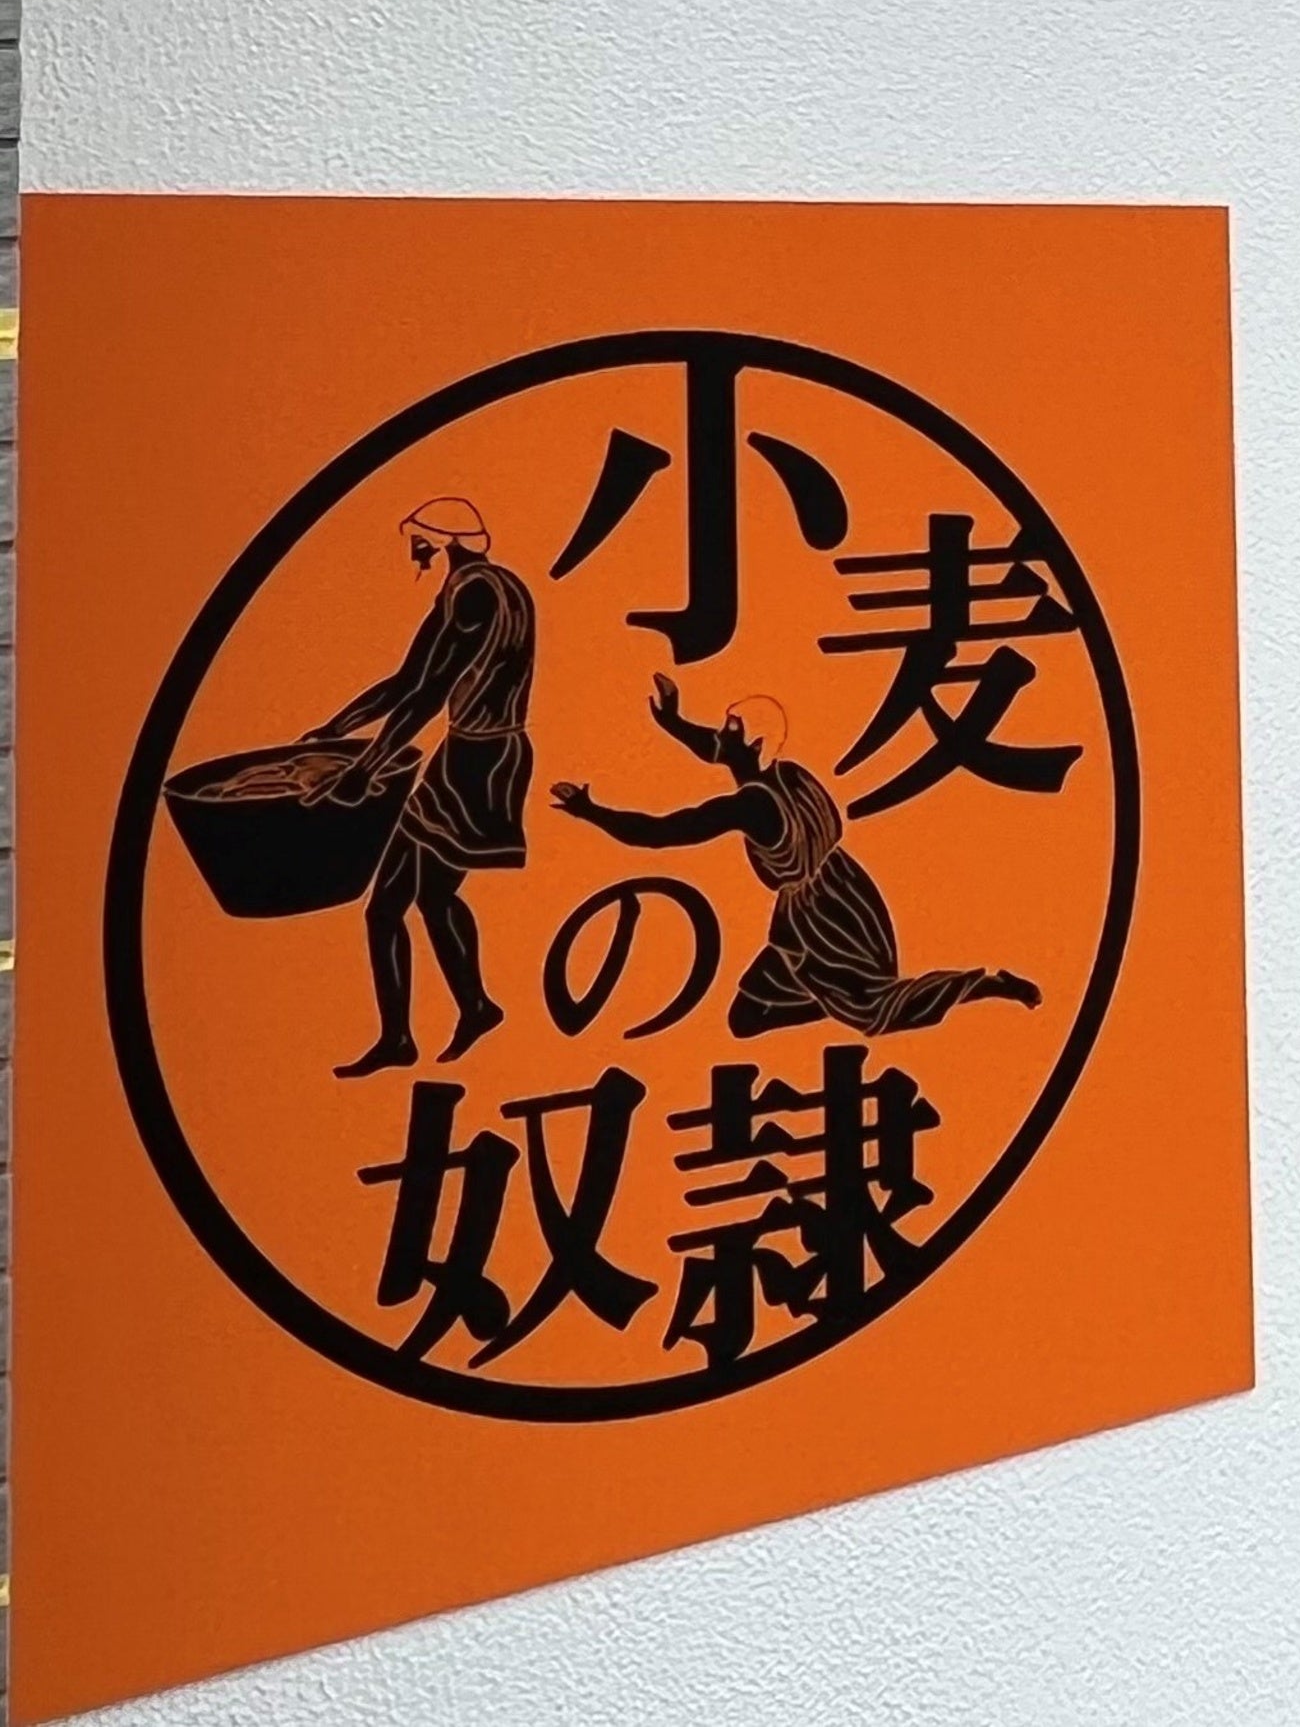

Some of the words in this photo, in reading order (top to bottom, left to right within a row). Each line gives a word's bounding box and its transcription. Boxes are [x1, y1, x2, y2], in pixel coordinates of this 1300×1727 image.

[549, 359, 1085, 821] 小麦
[543, 874, 721, 1041] の
[357, 1042, 942, 1371] 奴隷
